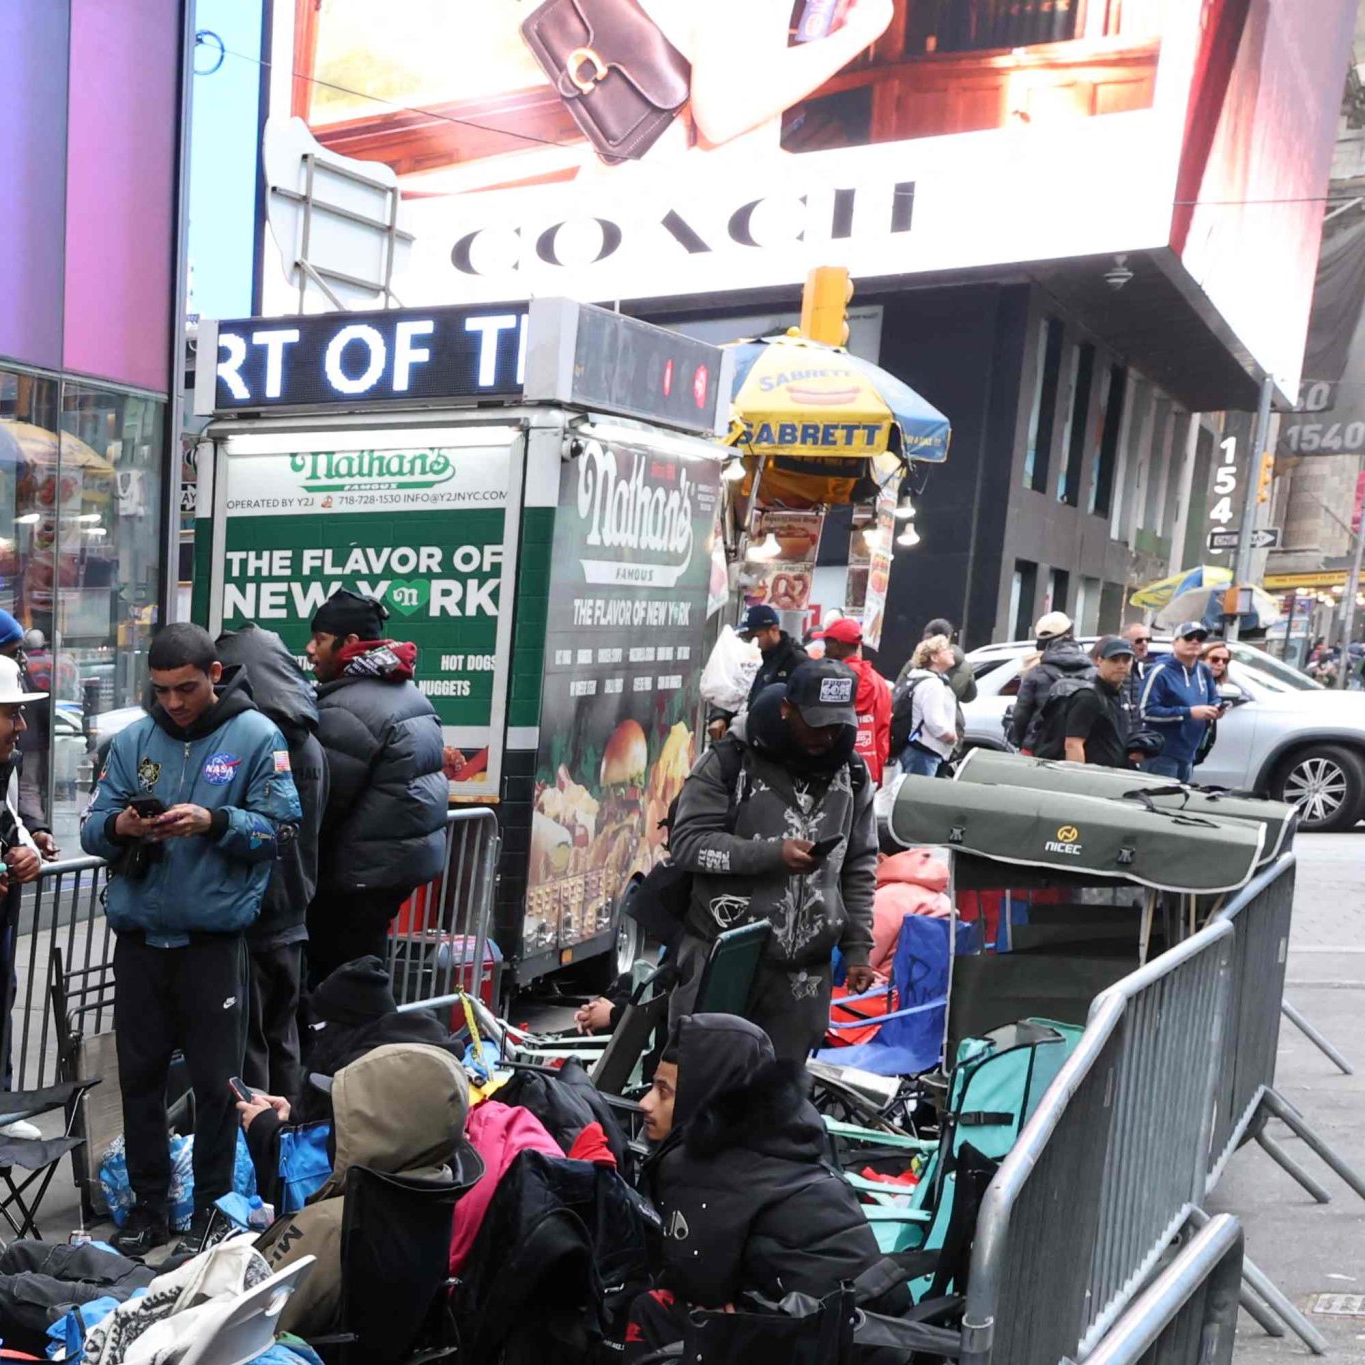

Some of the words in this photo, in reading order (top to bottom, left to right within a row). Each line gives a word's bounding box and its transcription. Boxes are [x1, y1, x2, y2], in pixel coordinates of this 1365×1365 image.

[324, 320, 434, 394] OF
[465, 314, 528, 388] T
[728, 423, 883, 447] SABRETT
[290, 448, 452, 481] Nathan's
[227, 498, 280, 510] OPERATED
[281, 498, 294, 508] BY
[578, 441, 692, 554] Nathan's
[226, 551, 291, 577] THE
[302, 546, 442, 575] FLAVOR
[453, 544, 504, 573] OF
[615, 568, 654, 582] FAMOUS
[223, 580, 343, 619] NEW
[573, 599, 593, 625] THE
[594, 599, 632, 626] FLAVOR
[633, 600, 647, 626] OF
[646, 601, 668, 626] NEW
[441, 655, 465, 671] HOT
[419, 680, 471, 696] NUGGETS
[205, 763, 235, 775] NASA
